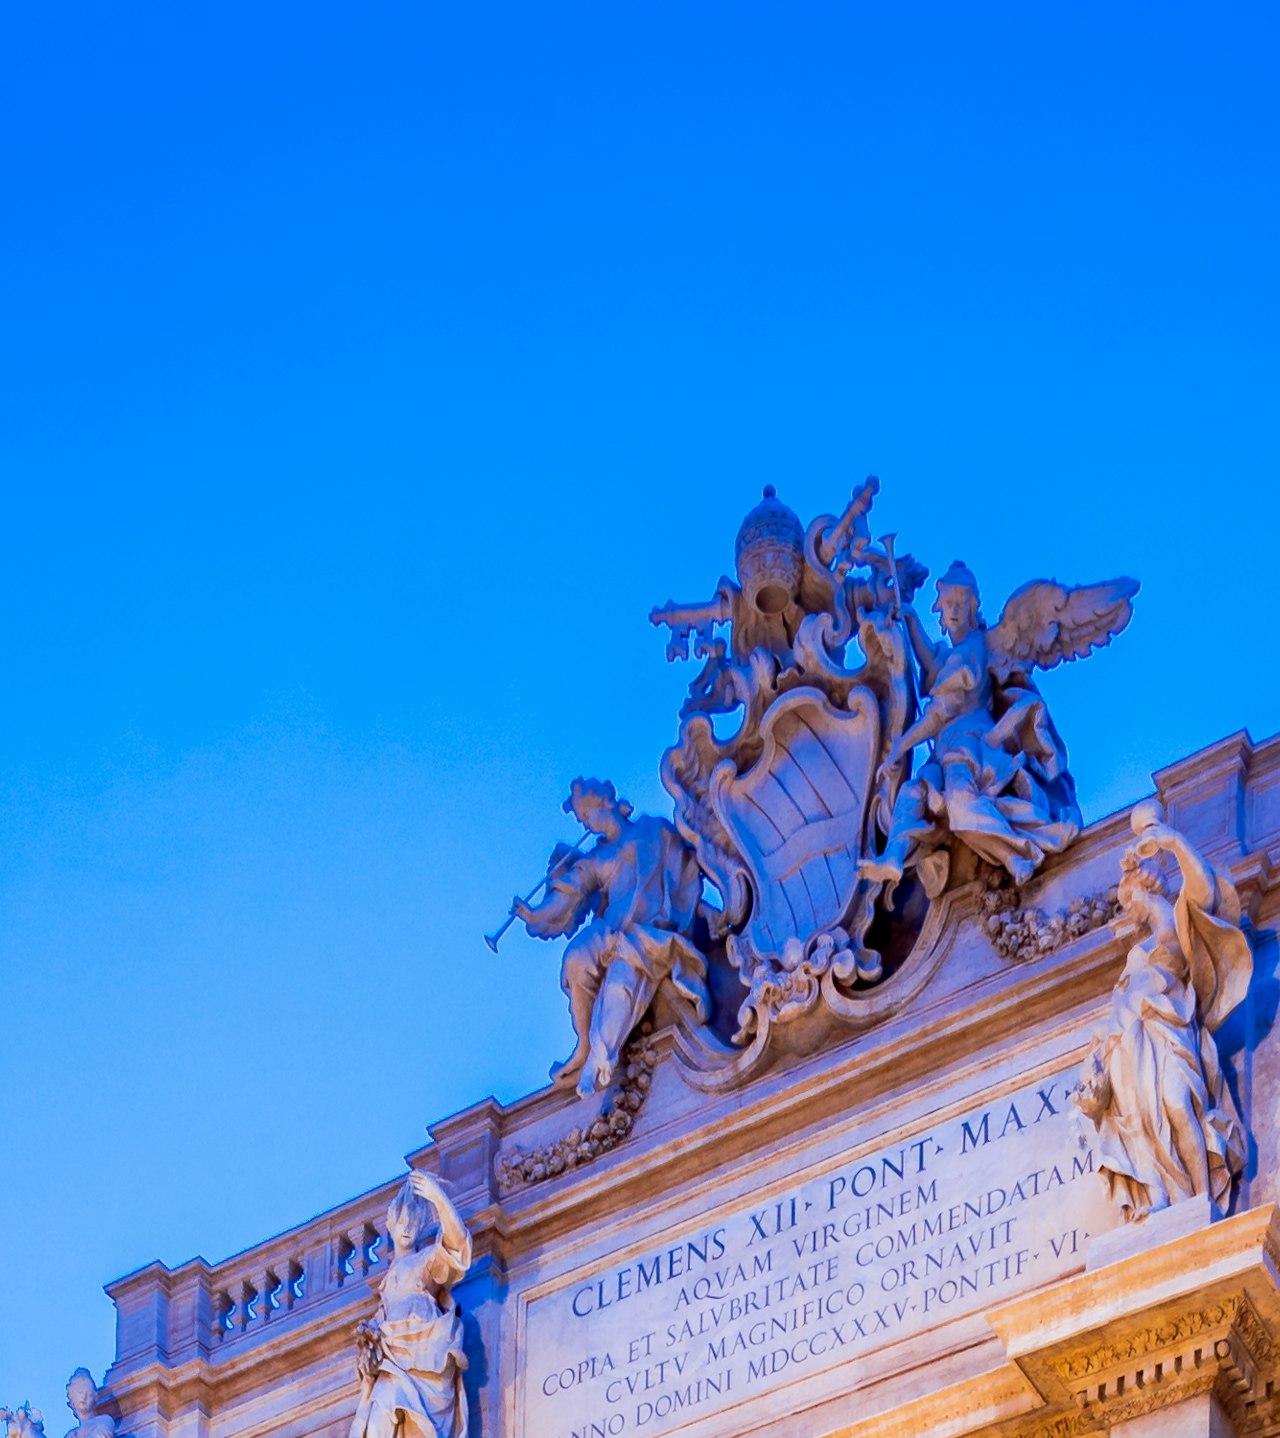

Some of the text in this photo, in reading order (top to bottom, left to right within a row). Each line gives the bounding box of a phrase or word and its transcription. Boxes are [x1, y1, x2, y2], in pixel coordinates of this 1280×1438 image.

[542, 1150, 1094, 1397] COPIA ET SALVBRITATE COMMENDATAM
[571, 1228, 726, 1318] CLEMENS
[605, 1217, 1018, 1404] CVLTV MAGNIFICO ORNAVIT
[673, 1178, 938, 1311] AQVAM VIRGINEM
[635, 1369, 733, 1427] DOMINI
